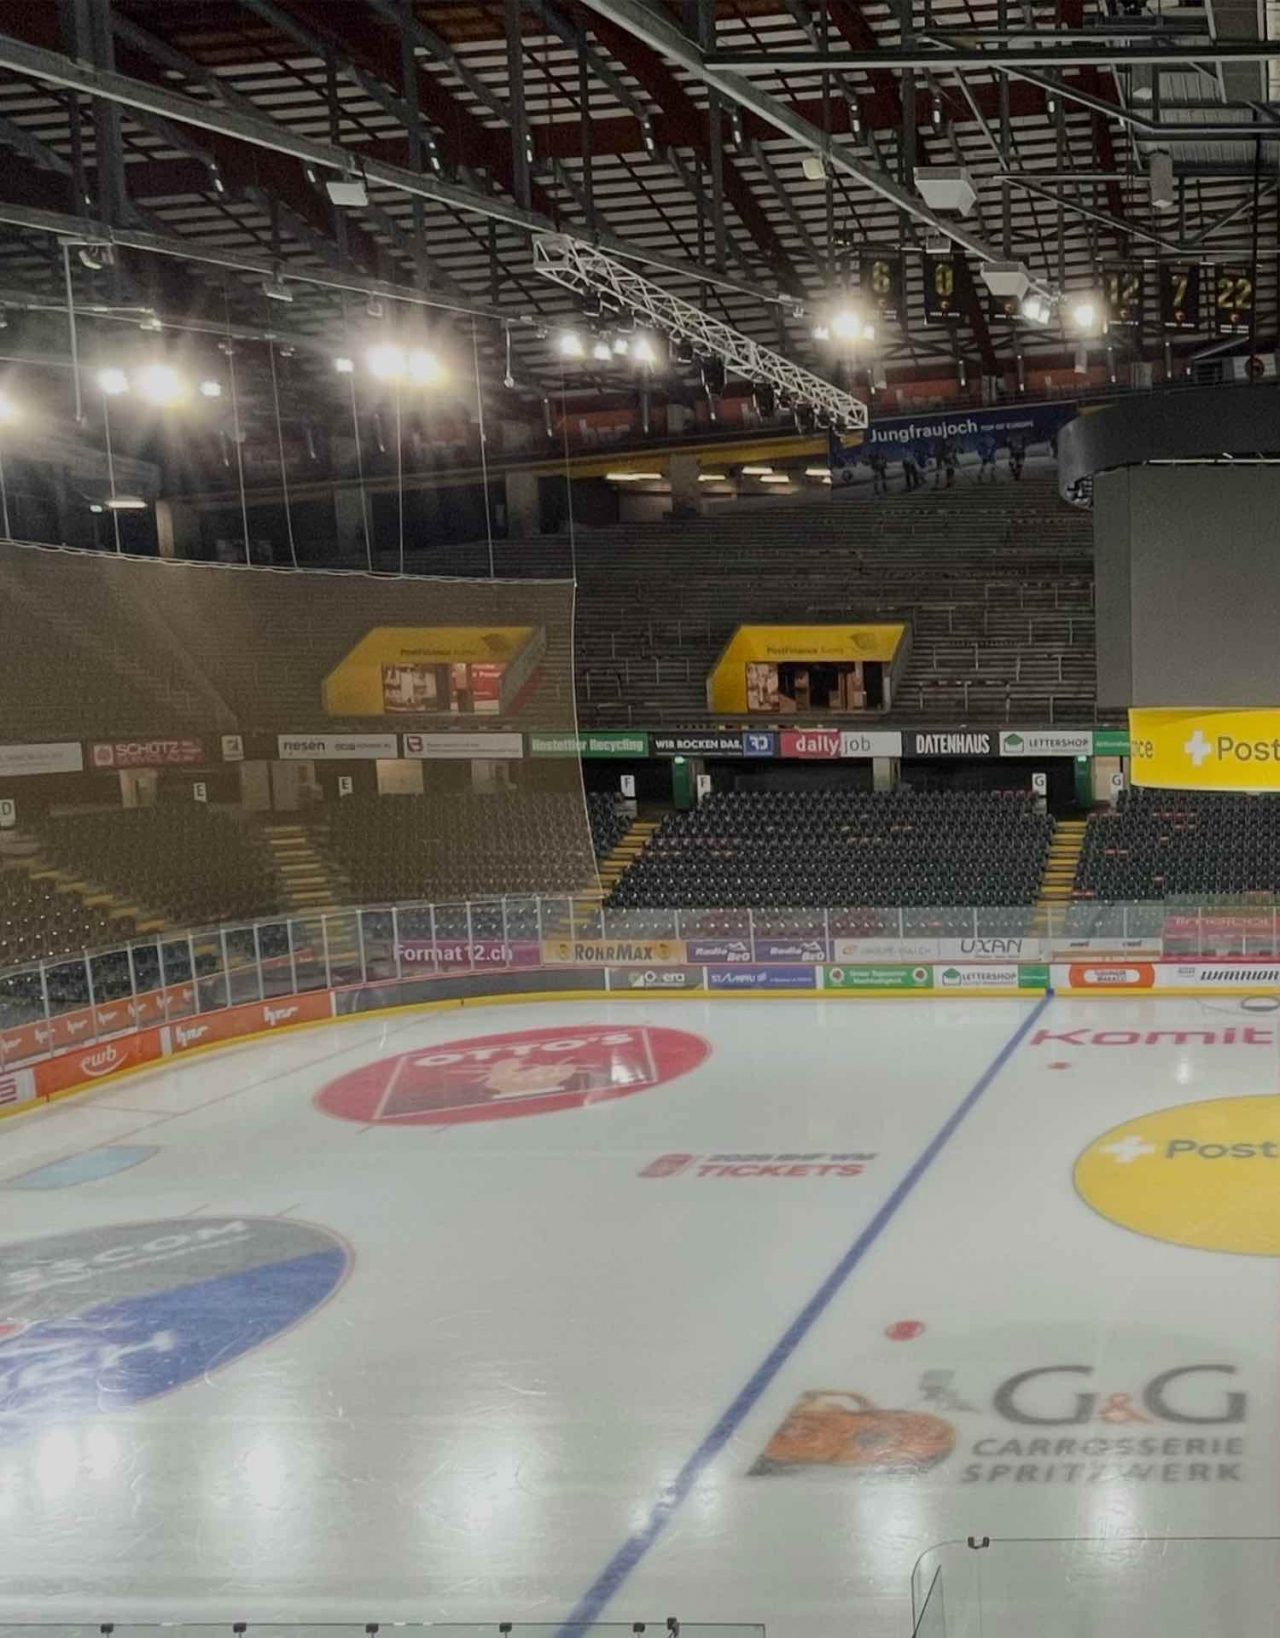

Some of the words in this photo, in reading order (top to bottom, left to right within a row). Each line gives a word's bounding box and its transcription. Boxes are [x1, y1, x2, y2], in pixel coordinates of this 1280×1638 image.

[1218, 279, 1252, 309] 22
[870, 419, 978, 444] Jungfraujoch
[656, 740, 675, 749] WIR
[677, 740, 718, 749] ROCKEN
[916, 733, 990, 754] DATENHAUS
[1029, 738, 1088, 749] LETTERSHOP
[624, 776, 631, 788] F
[1035, 775, 1044, 787] G
[1112, 775, 1121, 786] G
[395, 944, 462, 961] Format
[961, 939, 1022, 953] UXAN
[962, 972, 1016, 980] LETTERSHOP
[1031, 1027, 1273, 1046] Komit
[414, 1031, 635, 1068] OTTO'S
[698, 1164, 868, 1177] TICKETS
[993, 1364, 1248, 1427] G&G
[972, 1436, 1244, 1457] CARROSSERIE
[958, 1462, 1242, 1483] SPRITZWERK
